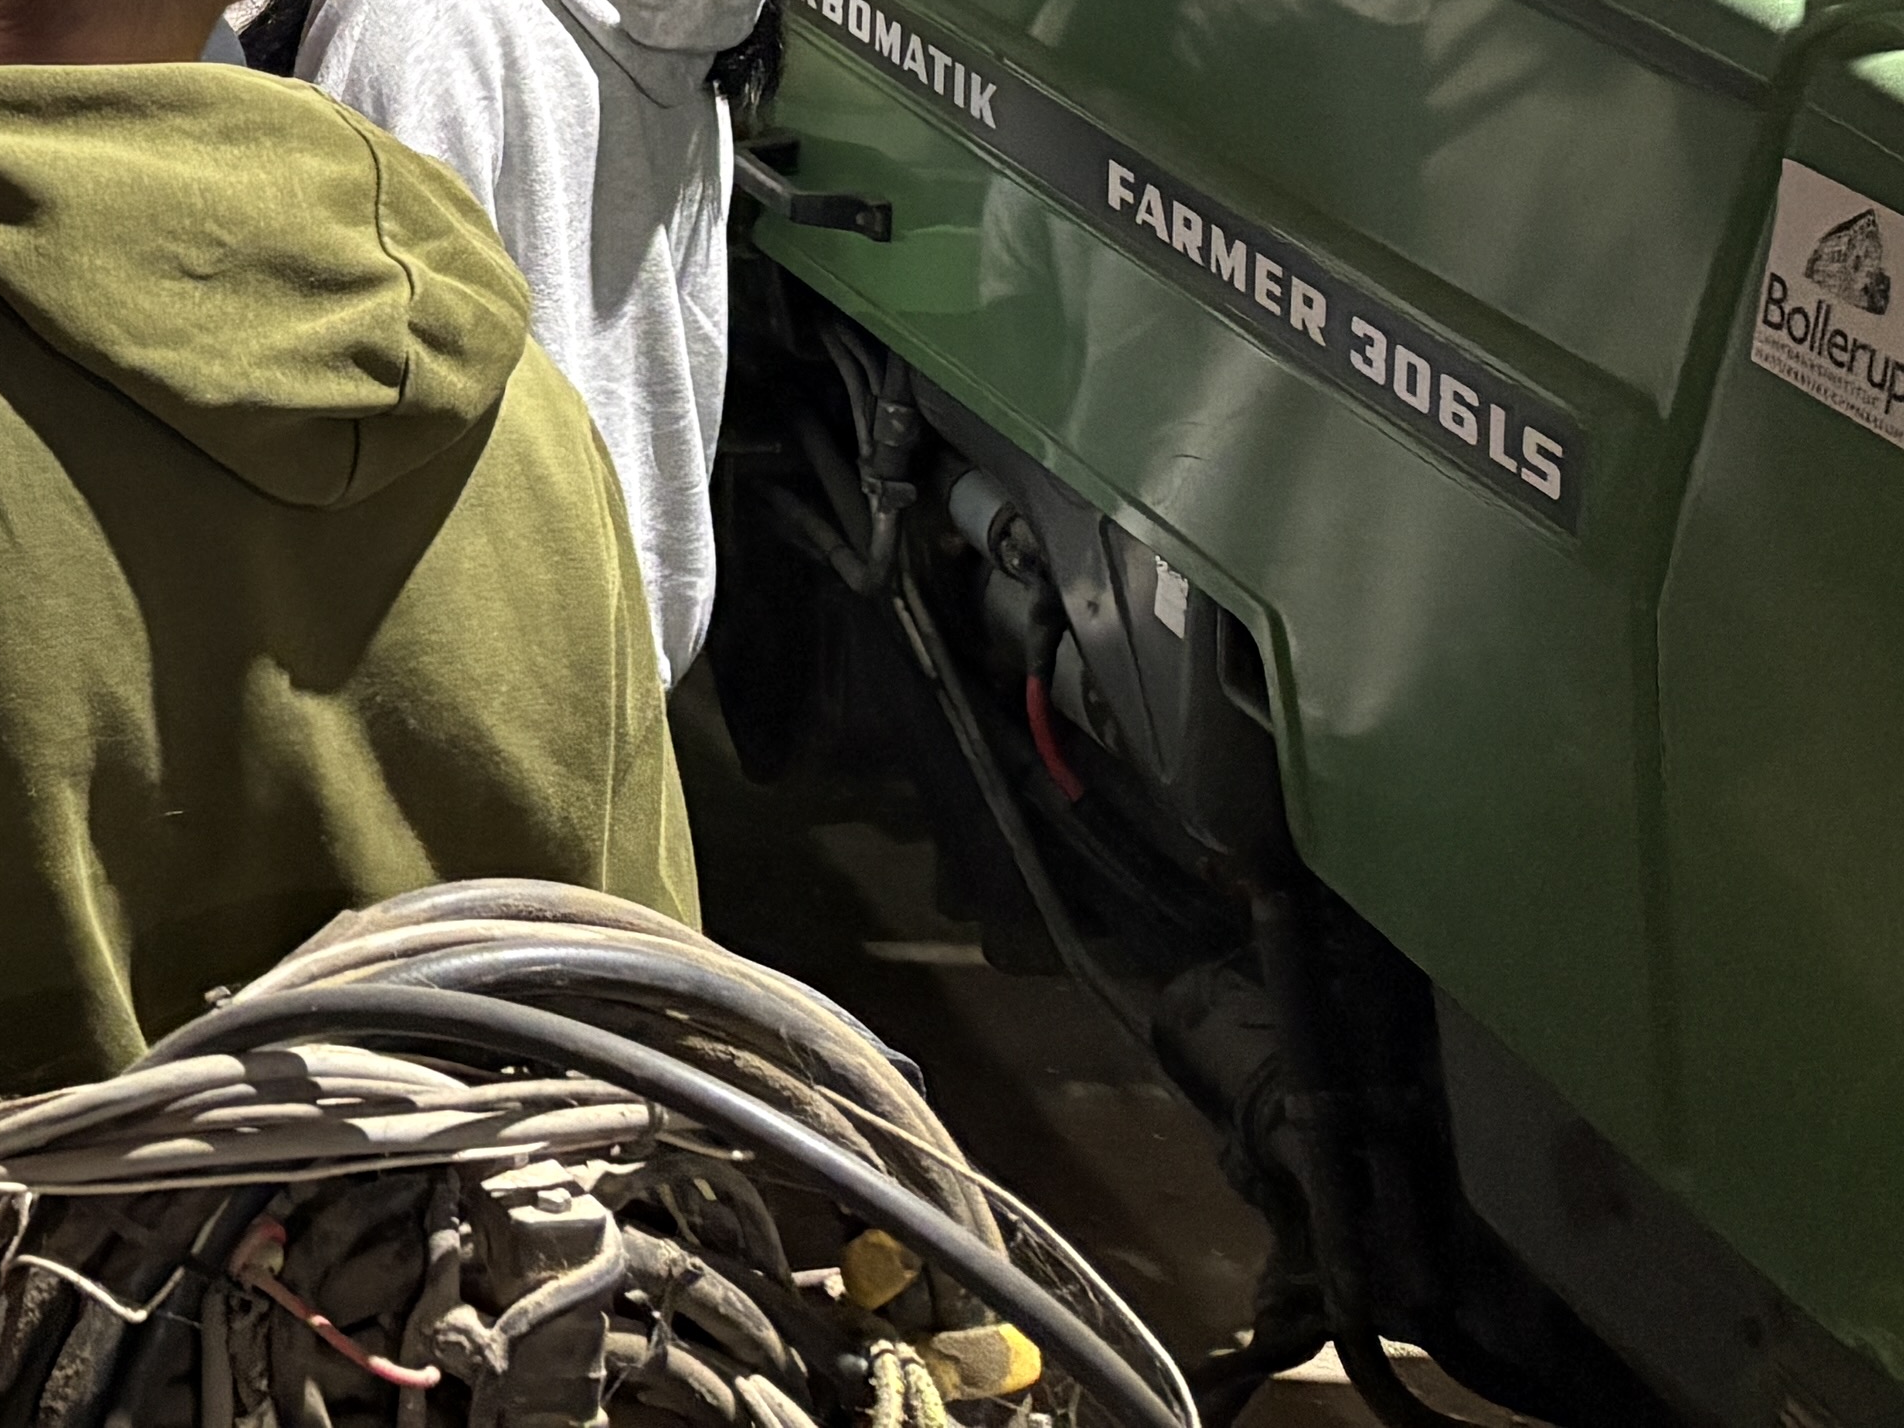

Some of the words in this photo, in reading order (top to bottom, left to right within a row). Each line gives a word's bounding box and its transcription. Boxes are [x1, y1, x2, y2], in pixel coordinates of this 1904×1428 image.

[1107, 158, 1327, 347] FARMER
[1349, 315, 1564, 501] 306LS
[1762, 271, 1904, 415] Bollerup
